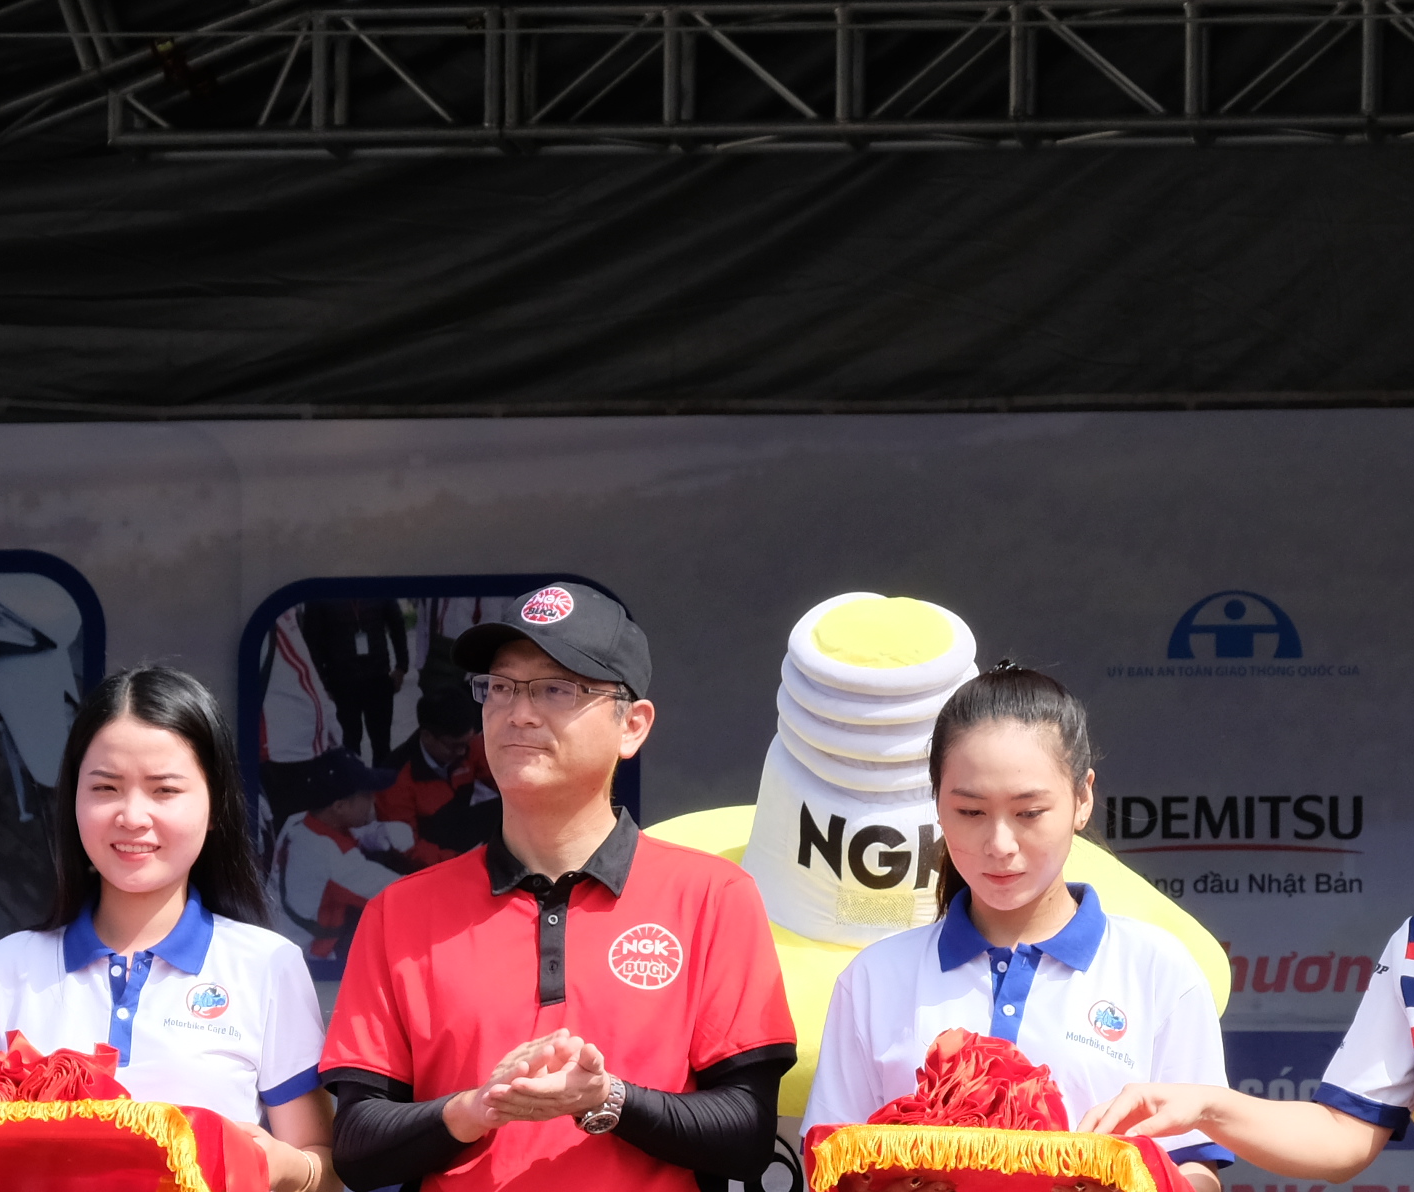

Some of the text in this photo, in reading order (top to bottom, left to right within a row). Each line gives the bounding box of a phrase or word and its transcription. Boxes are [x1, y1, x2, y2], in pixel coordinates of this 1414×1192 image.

[1157, 666, 1175, 677] AN
[1106, 795, 1363, 840] IDEMITSU
[1193, 871, 1238, 894] đầu
[1248, 873, 1306, 898] Nhật
[1315, 870, 1362, 894] Bản
[622, 938, 669, 956] NGK
[623, 961, 667, 978] BUGI
[163, 1018, 242, 1041] Motorbike Care Day
[1066, 1031, 1135, 1069] Motorbike Care Day
